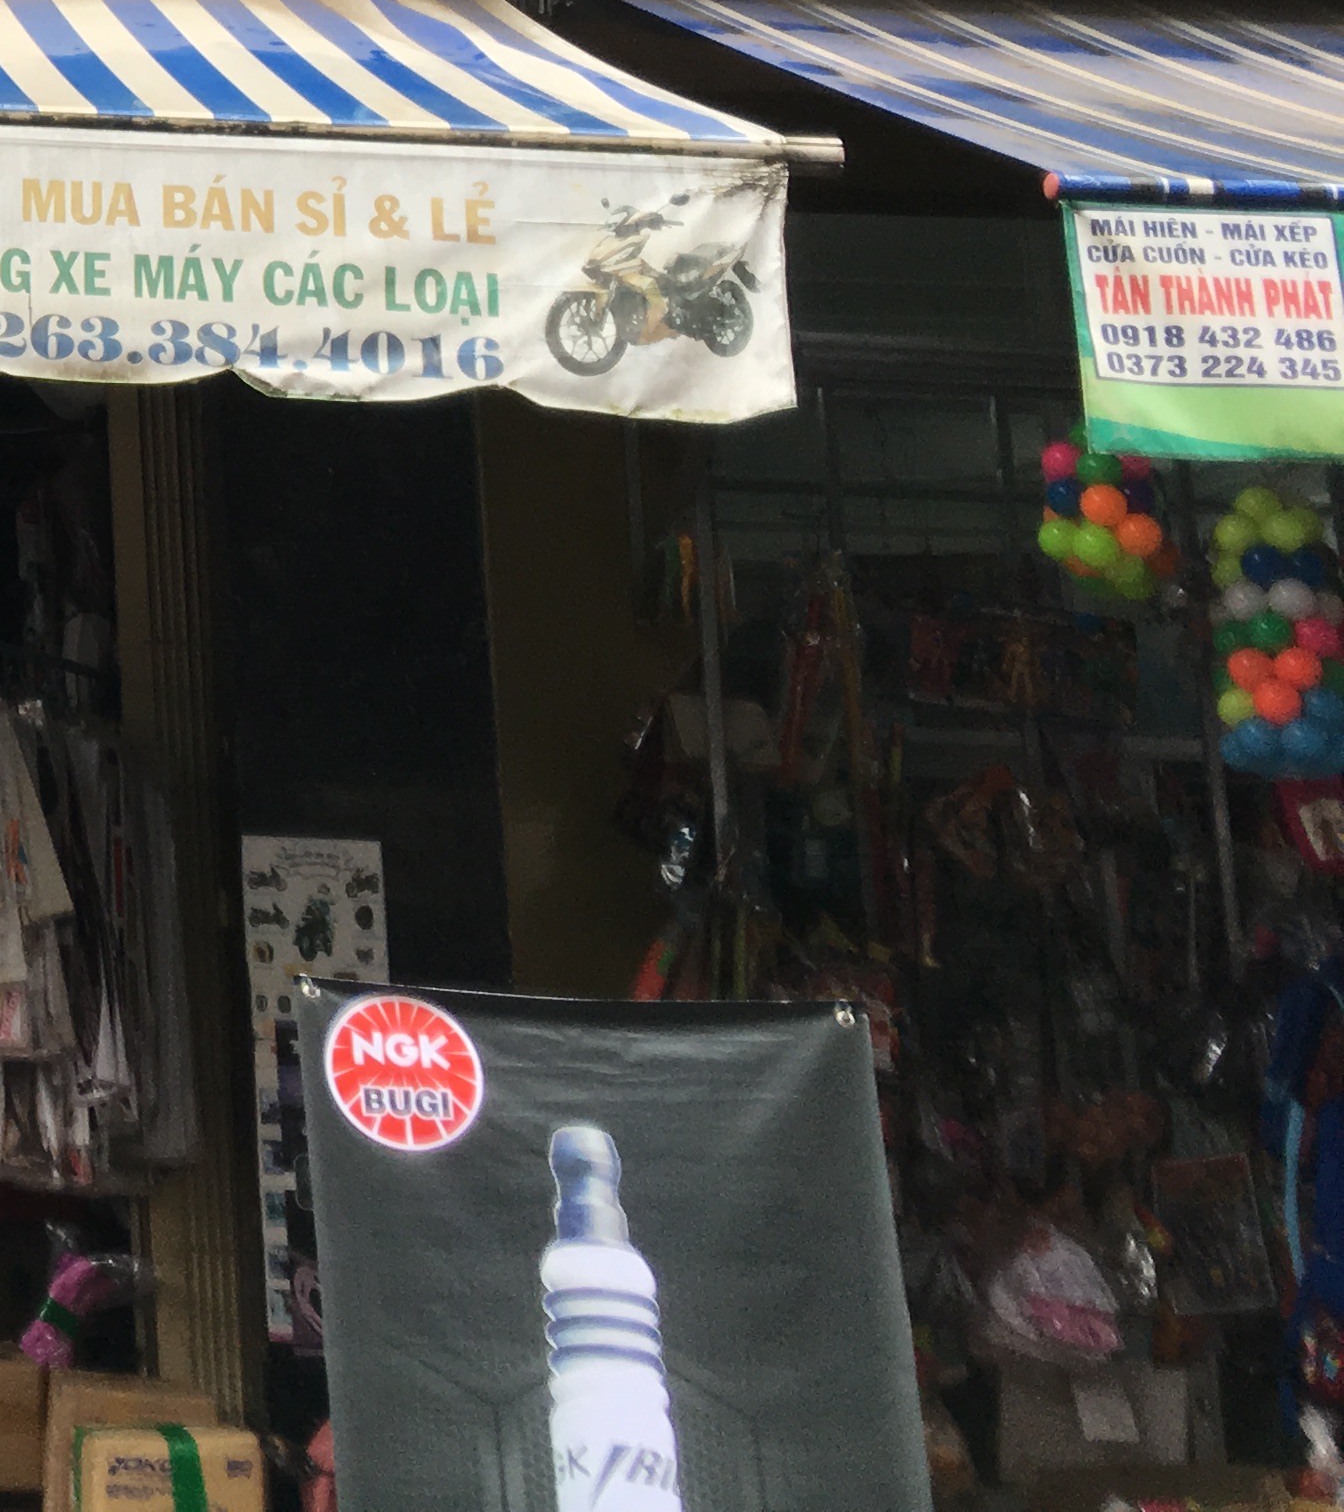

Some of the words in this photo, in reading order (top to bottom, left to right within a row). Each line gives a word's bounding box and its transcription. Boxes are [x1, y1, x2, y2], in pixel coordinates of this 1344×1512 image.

[21, 179, 142, 228] MUA
[162, 170, 278, 237] BÁN
[295, 175, 349, 239] SỈ
[430, 180, 498, 246] LẺ
[1090, 216, 1135, 238] MÁI
[1143, 217, 1197, 239] HIÊN
[1221, 219, 1266, 241] MÁI
[1273, 218, 1317, 243] XẾP
[1087, 238, 1135, 264] CỬA
[1230, 242, 1277, 267] CỬA
[49, 248, 113, 297] XE
[132, 243, 243, 303] MÁY
[262, 249, 366, 310] CÁC
[384, 265, 502, 328] LOẠI
[1094, 266, 1152, 315] TÂN
[1159, 267, 1257, 318] THÀNH
[1262, 271, 1334, 321] PHÁT
[1101, 324, 1186, 348] 0918
[1198, 325, 1264, 349] 432
[1274, 328, 1338, 352] 486
[1106, 353, 1188, 378] 0373
[1201, 355, 1268, 379] 224
[1279, 357, 1342, 381] 345
[352, 1032, 449, 1071] NGK
[362, 1087, 453, 1121] BUGI
